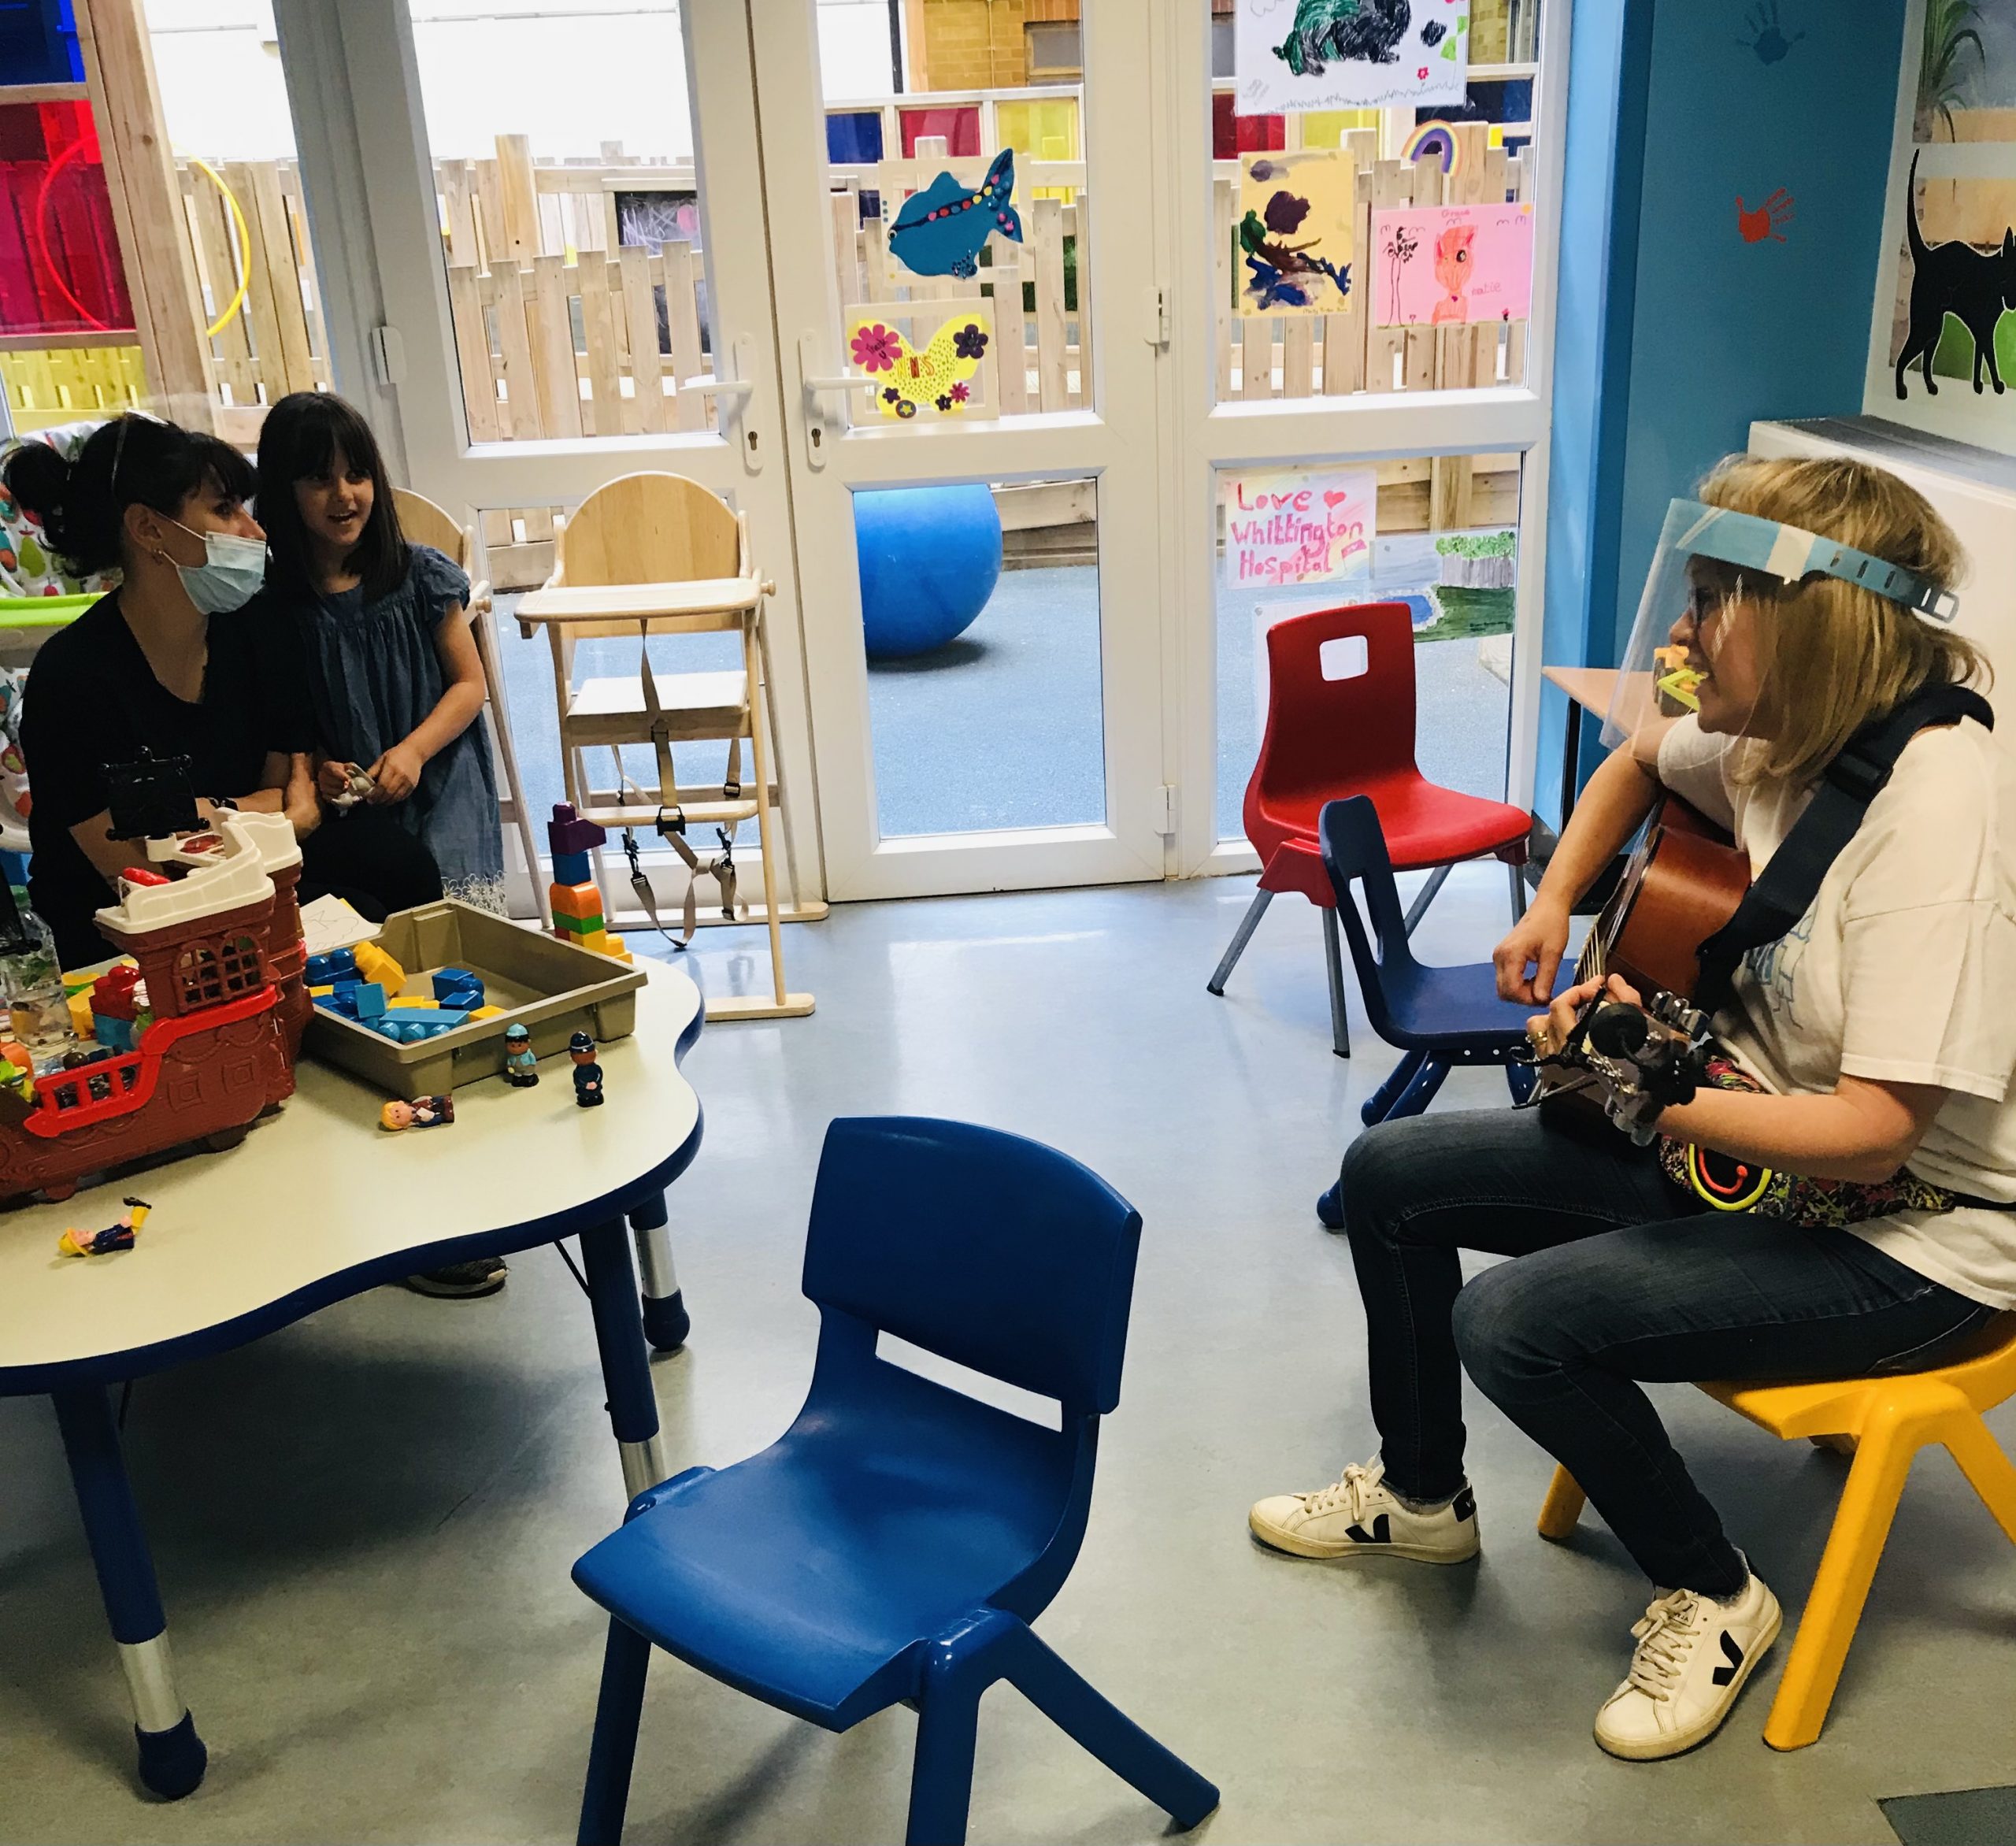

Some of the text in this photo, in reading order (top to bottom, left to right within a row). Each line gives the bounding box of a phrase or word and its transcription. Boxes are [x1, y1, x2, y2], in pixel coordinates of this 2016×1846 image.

[1237, 483, 1313, 512] Love
[1230, 512, 1364, 558] Whittington
[1240, 543, 1333, 584] Hospital
